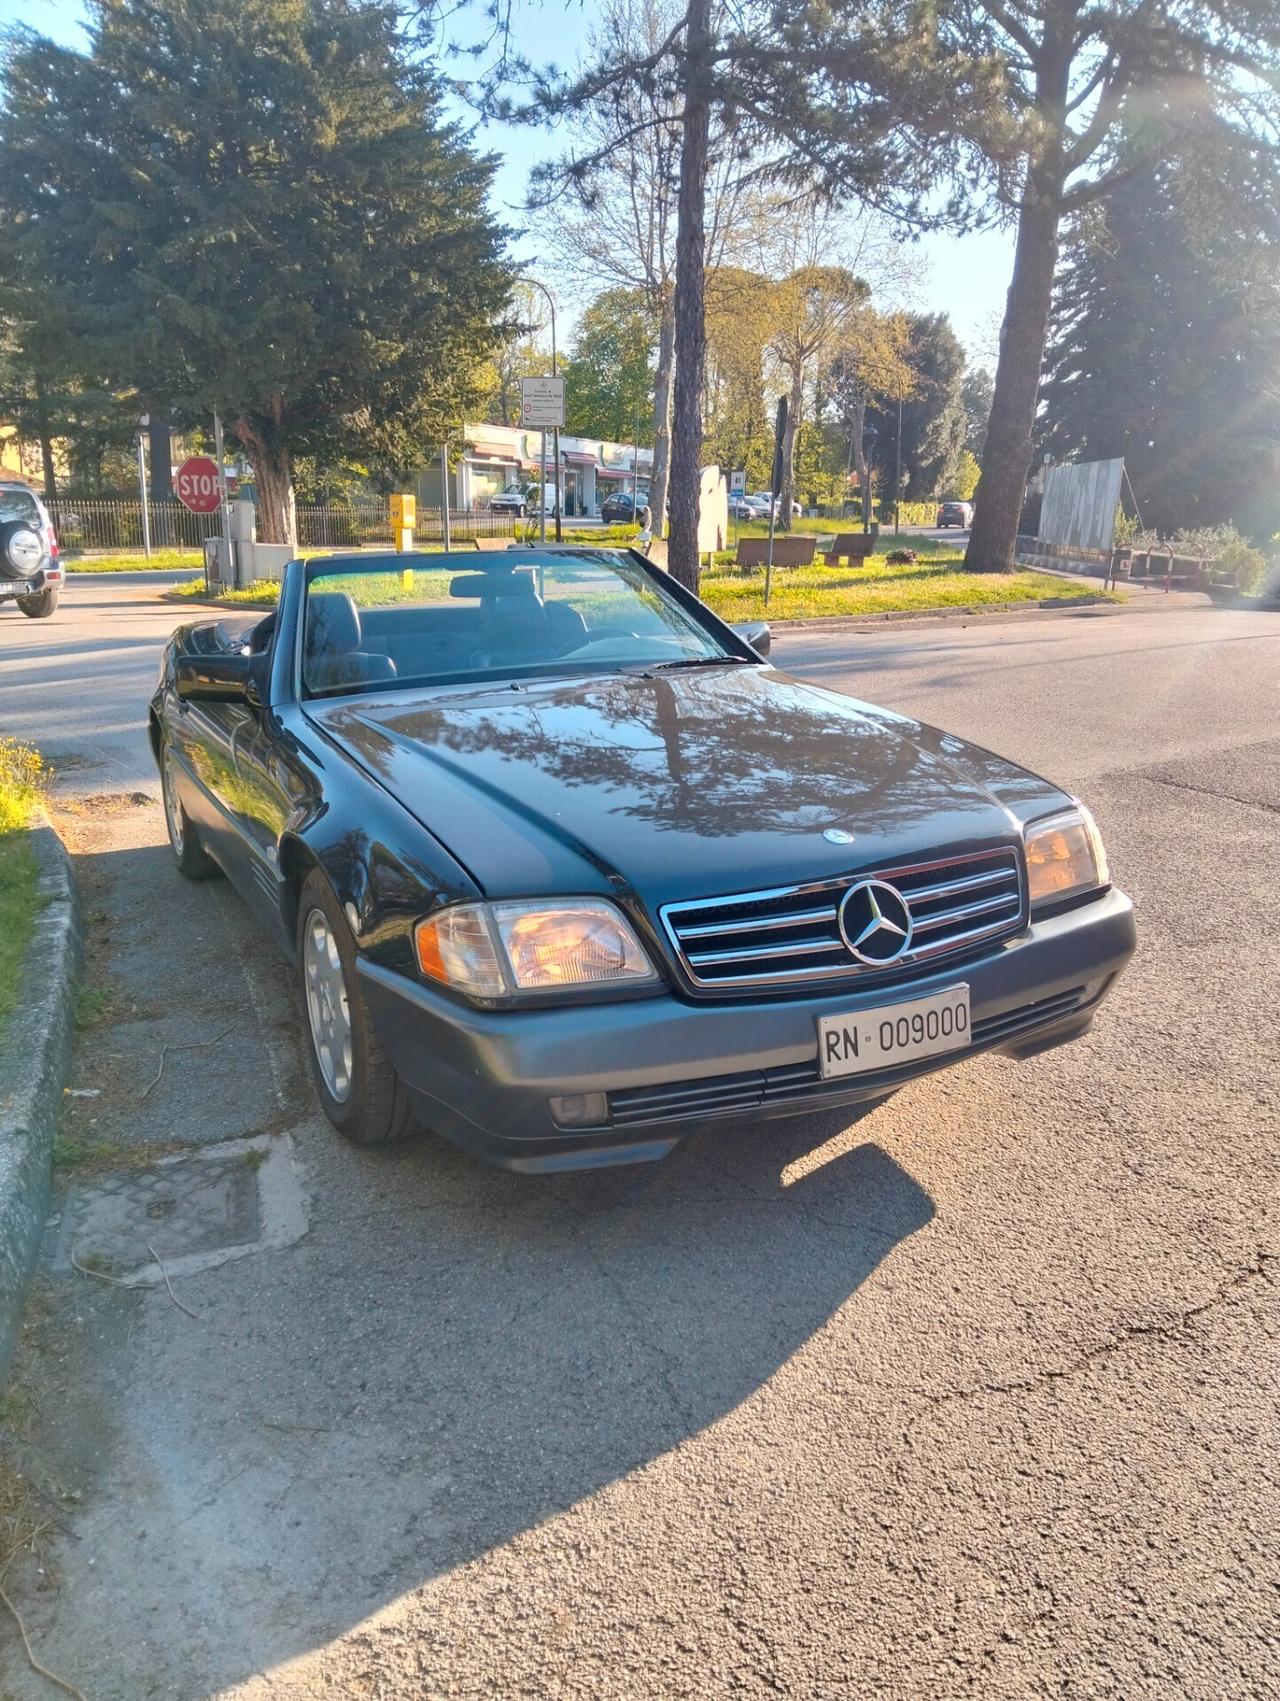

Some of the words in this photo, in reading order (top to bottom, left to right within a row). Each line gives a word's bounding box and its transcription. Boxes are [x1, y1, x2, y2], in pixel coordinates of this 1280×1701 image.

[180, 474, 220, 496] STOP
[825, 1026, 859, 1063] RN
[879, 1003, 967, 1051] 009000
